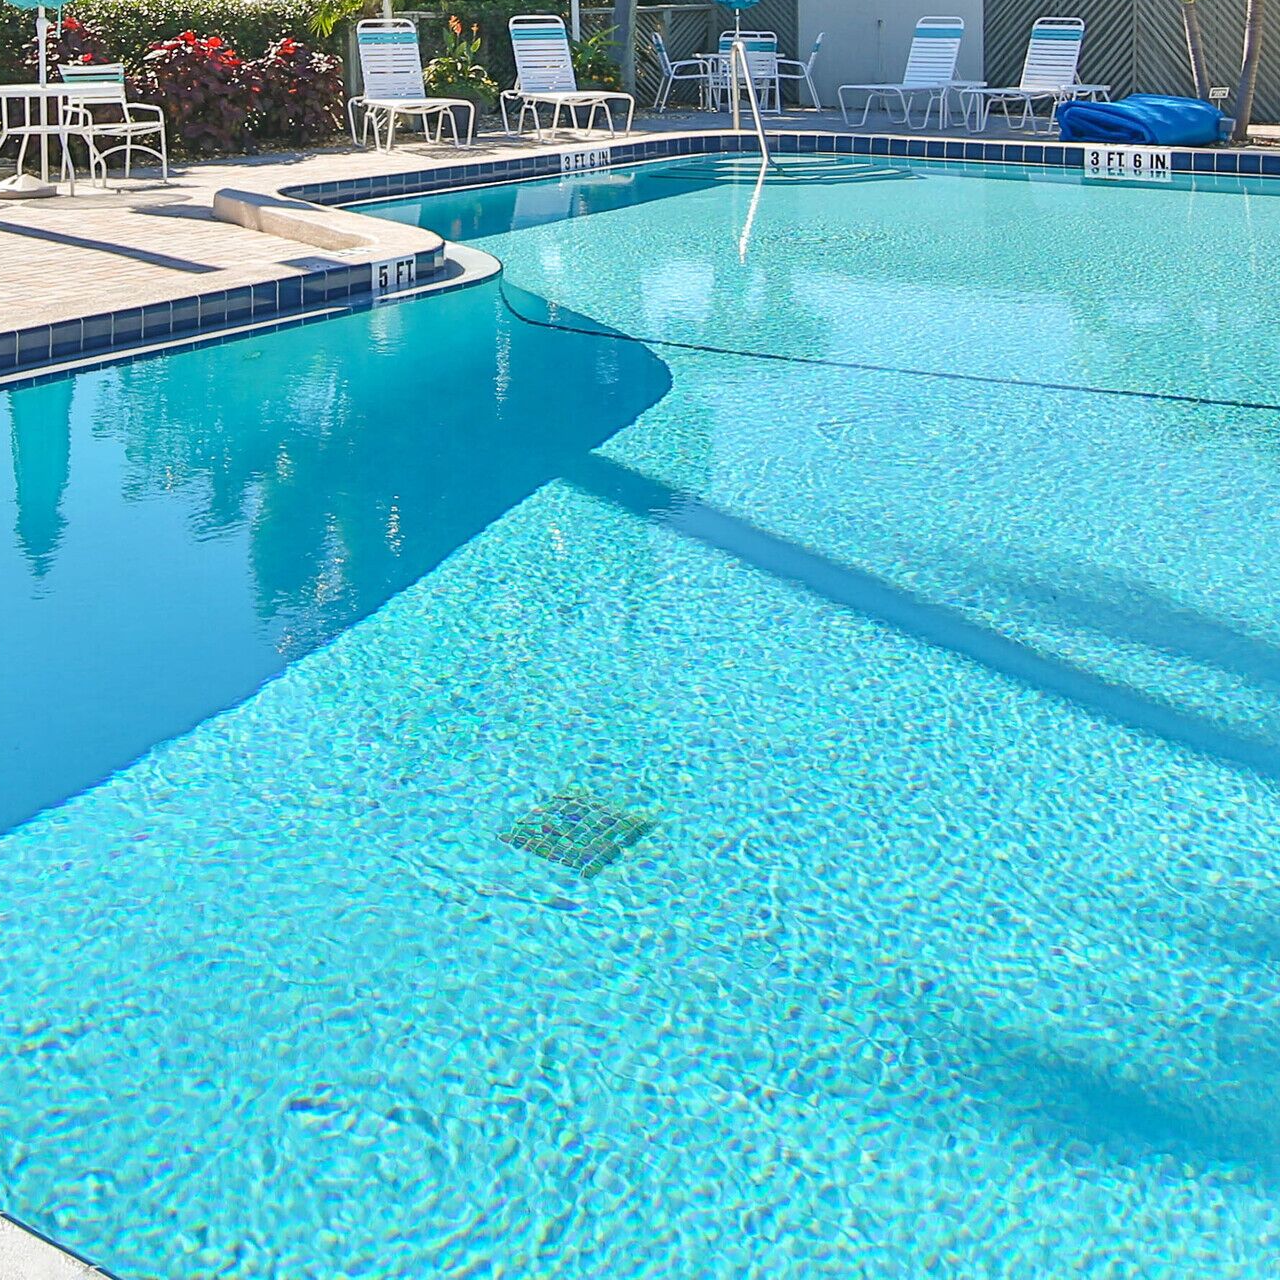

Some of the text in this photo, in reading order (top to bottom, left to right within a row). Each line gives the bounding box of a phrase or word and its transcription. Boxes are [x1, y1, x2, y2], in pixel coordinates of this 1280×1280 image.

[565, 156, 570, 170] 3
[1091, 151, 1169, 169] 3 FT. 6 IN.
[379, 265, 388, 288] 5
